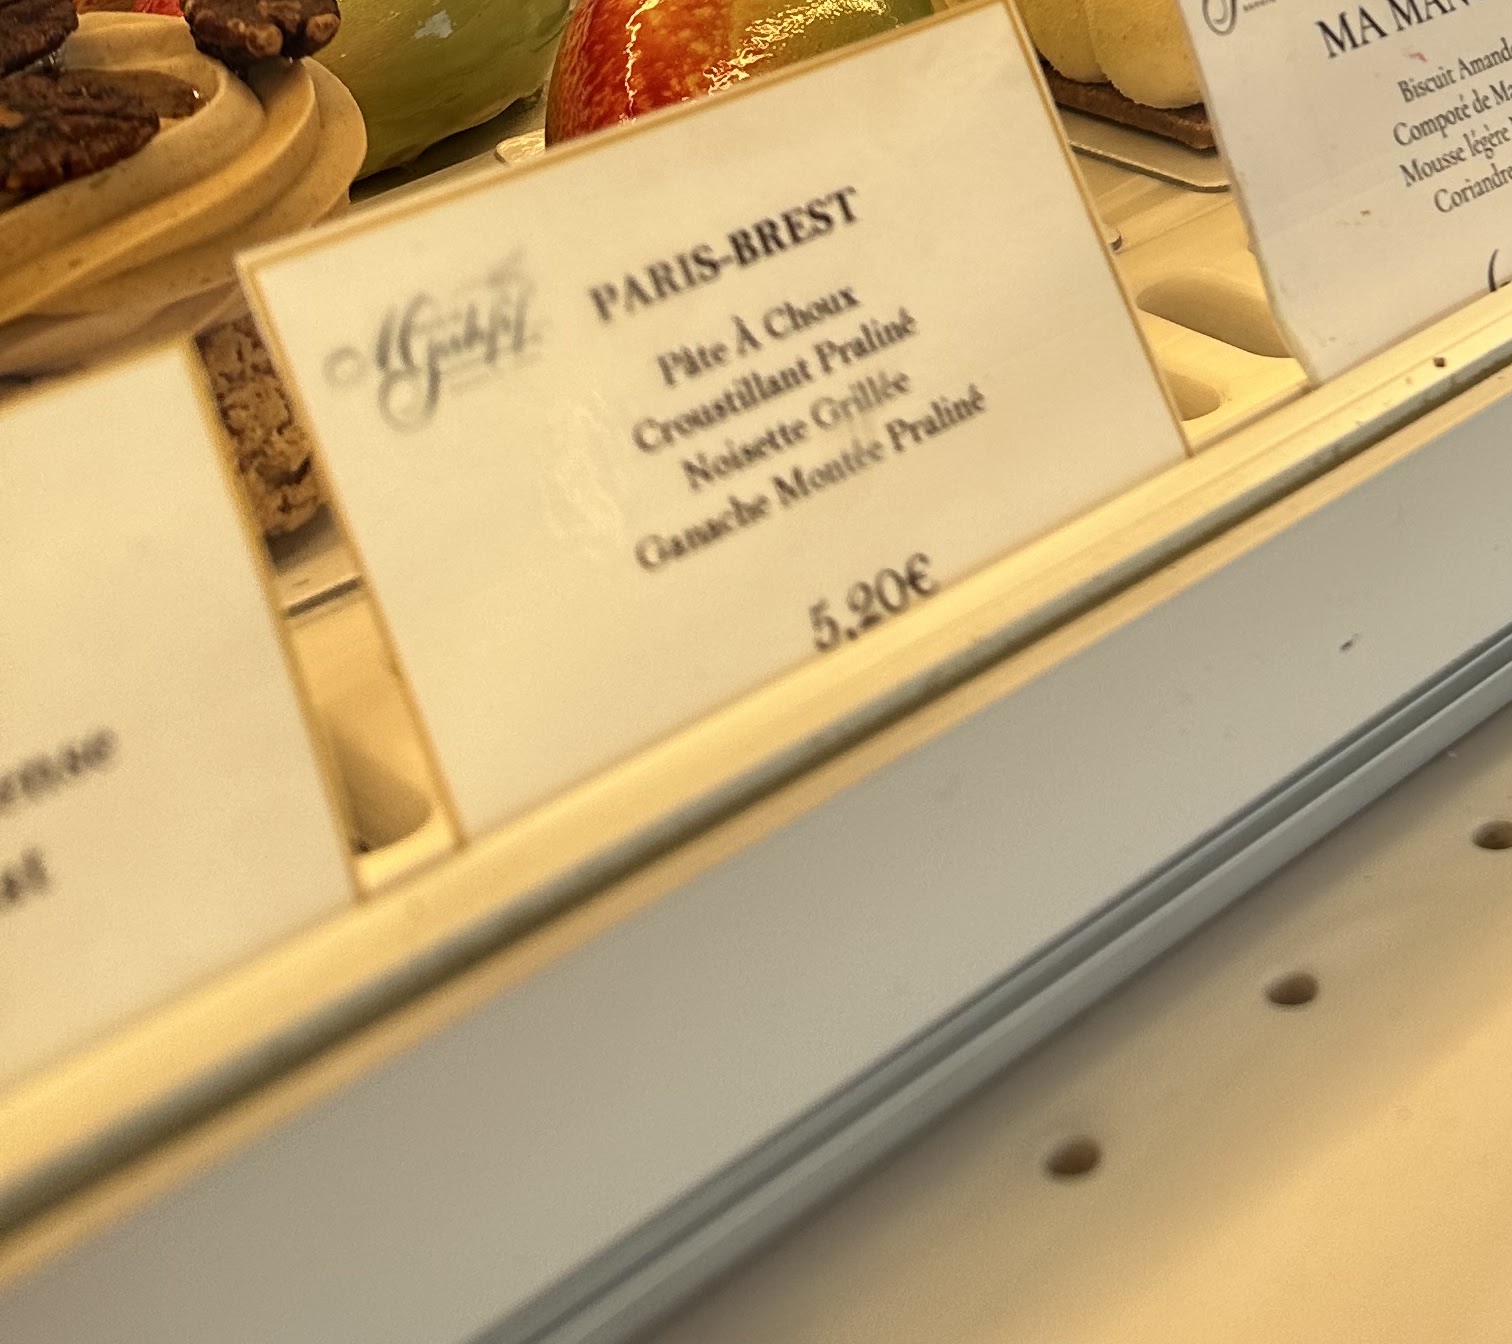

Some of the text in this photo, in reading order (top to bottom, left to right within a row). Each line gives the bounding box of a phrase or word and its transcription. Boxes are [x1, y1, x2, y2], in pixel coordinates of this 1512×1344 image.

[1315, 5, 1388, 60] MA
[1393, 94, 1471, 147] Compoté
[1472, 89, 1493, 112] de
[1397, 66, 1457, 104] Biscuit
[1399, 145, 1467, 188] Mousse
[1463, 124, 1511, 160] légère
[588, 186, 860, 324] PARIS-BREST
[632, 355, 814, 455] Croustillant
[815, 306, 918, 376] Praliné
[657, 286, 861, 388] Pâte À Choux
[635, 382, 988, 572] Ganache Montée Praliné
[682, 369, 911, 491] Noisette Grillée
[808, 552, 940, 654] 5.20€
